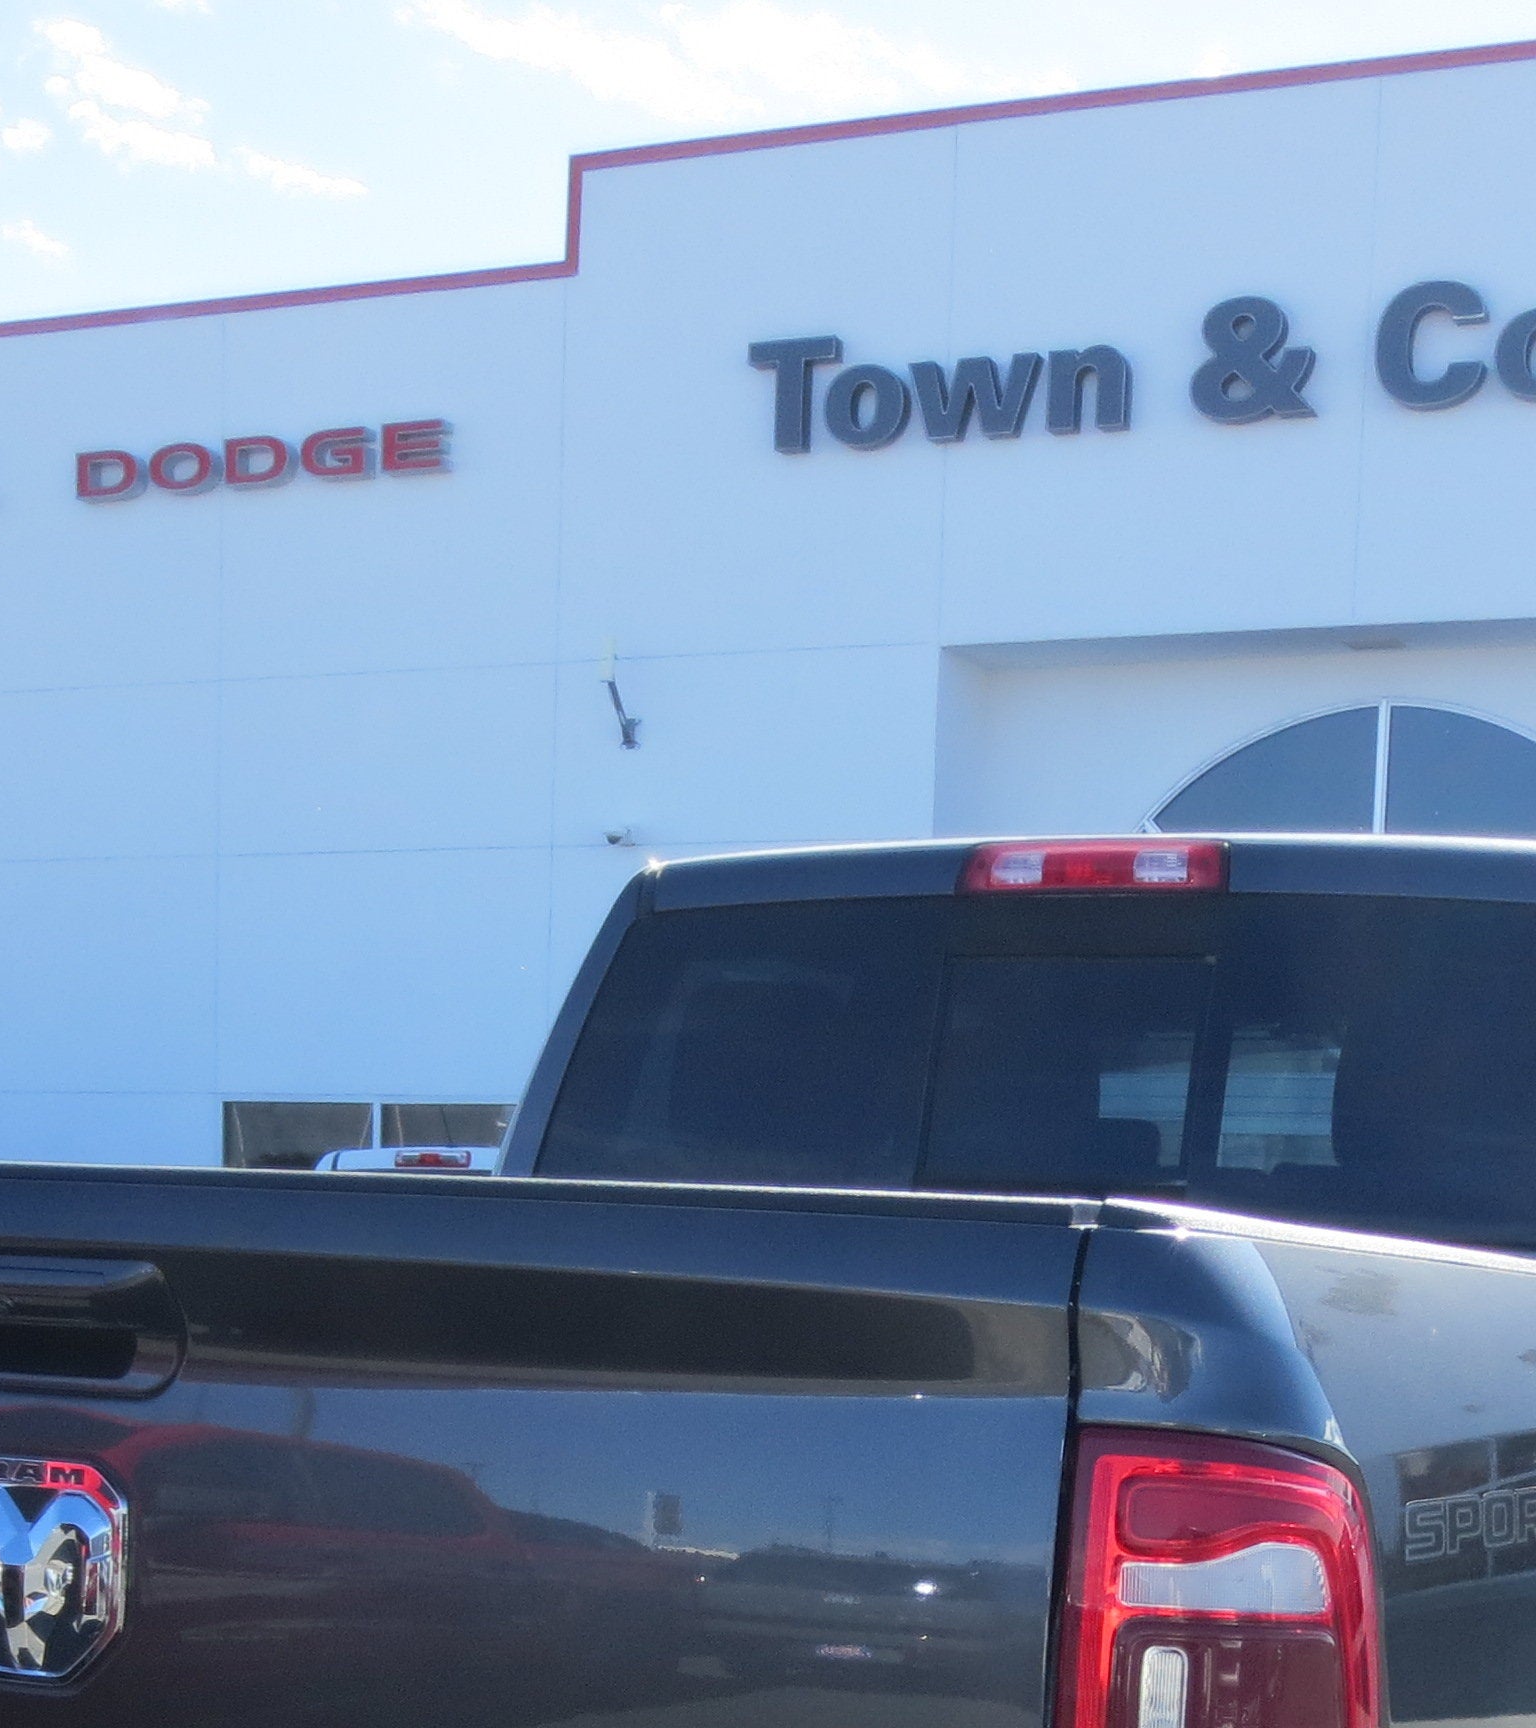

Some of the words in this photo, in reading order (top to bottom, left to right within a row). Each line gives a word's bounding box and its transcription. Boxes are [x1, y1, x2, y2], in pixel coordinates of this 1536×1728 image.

[748, 335, 1133, 455] Town
[1189, 295, 1317, 425] &
[76, 418, 454, 503] DODGE
